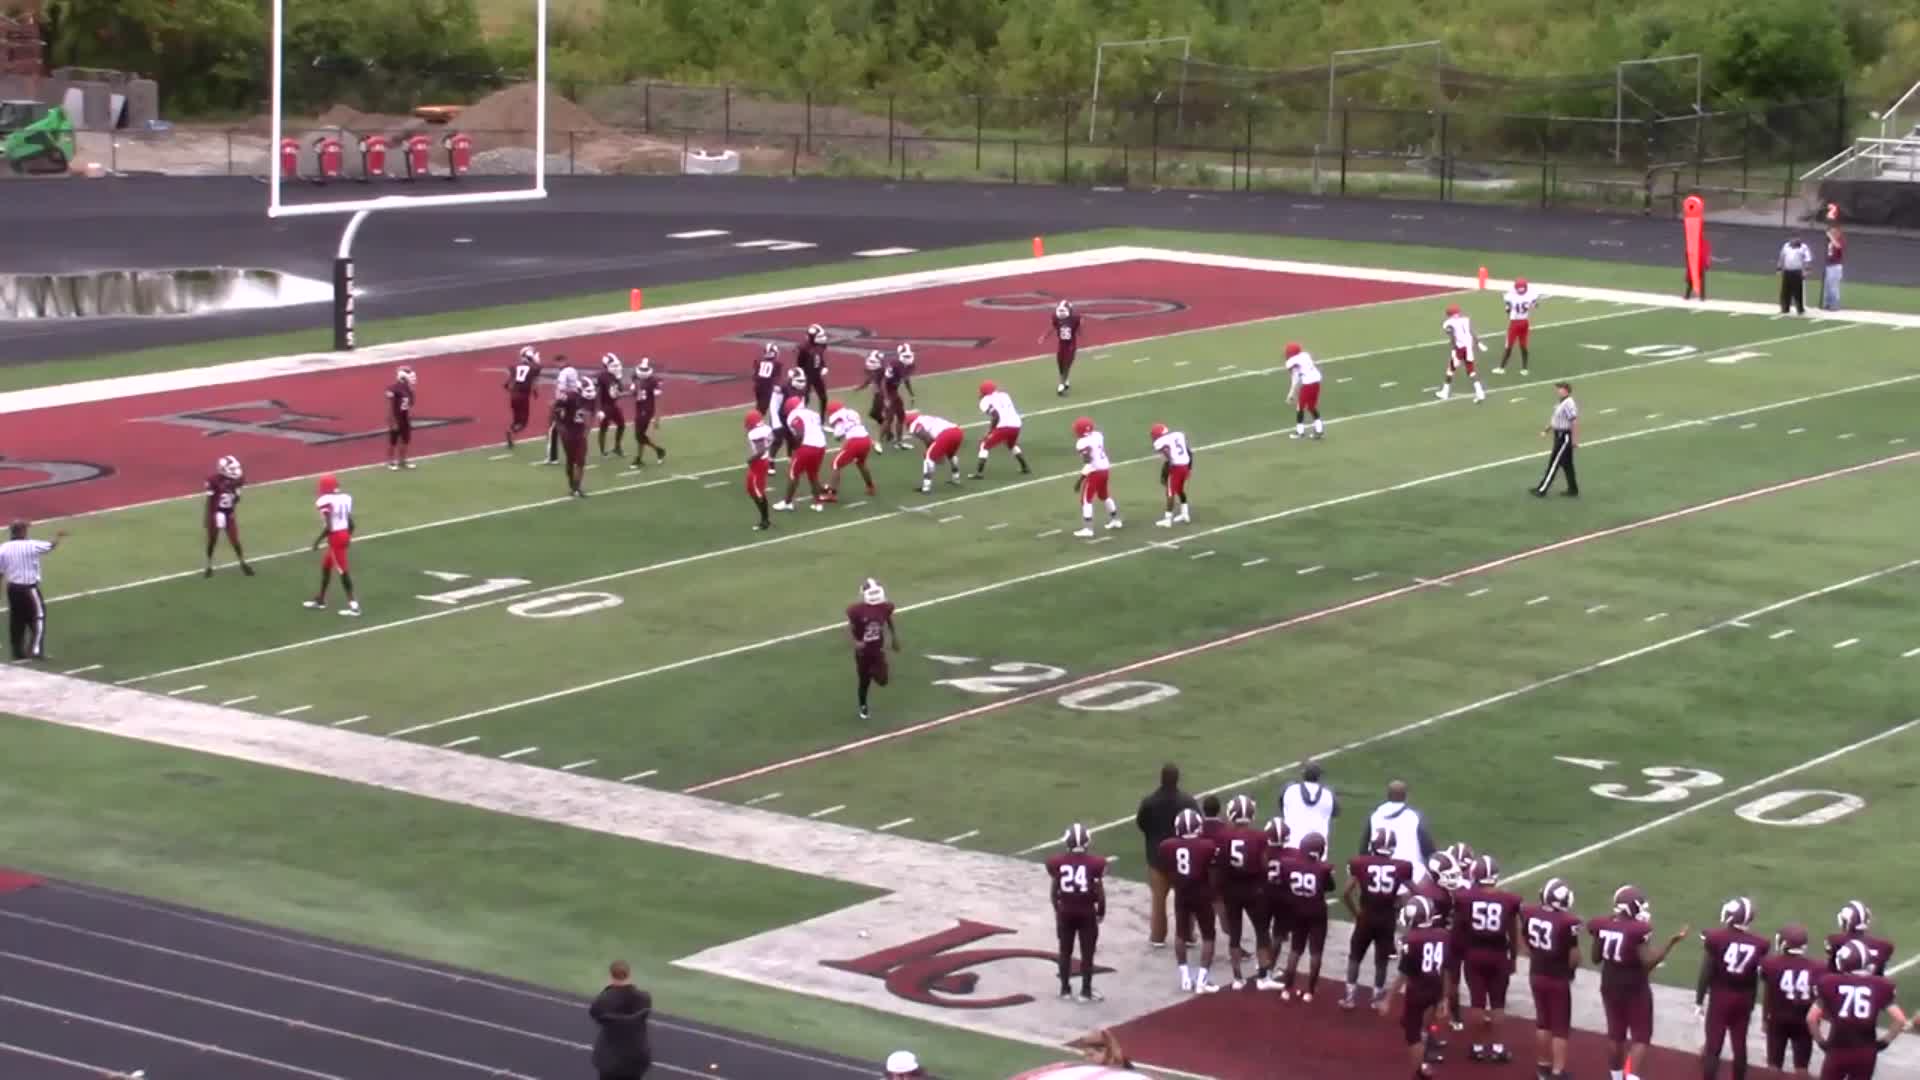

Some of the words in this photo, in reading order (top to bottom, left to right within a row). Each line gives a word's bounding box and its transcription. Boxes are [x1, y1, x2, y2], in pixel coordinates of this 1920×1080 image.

[931, 661, 1181, 711] 20
[1589, 766, 1866, 827] 30
[1175, 847, 1191, 876] 8
[1230, 839, 1246, 868] 5
[1059, 864, 1089, 893] 24
[1289, 871, 1317, 898] 29
[1367, 864, 1397, 894] 35
[1471, 901, 1503, 932] 58
[1527, 917, 1553, 951] 53
[1599, 929, 1624, 962] 77
[1421, 941, 1444, 973] 84
[1723, 942, 1756, 975] 47
[1779, 968, 1811, 1001] 44
[1837, 984, 1872, 1019] 76
